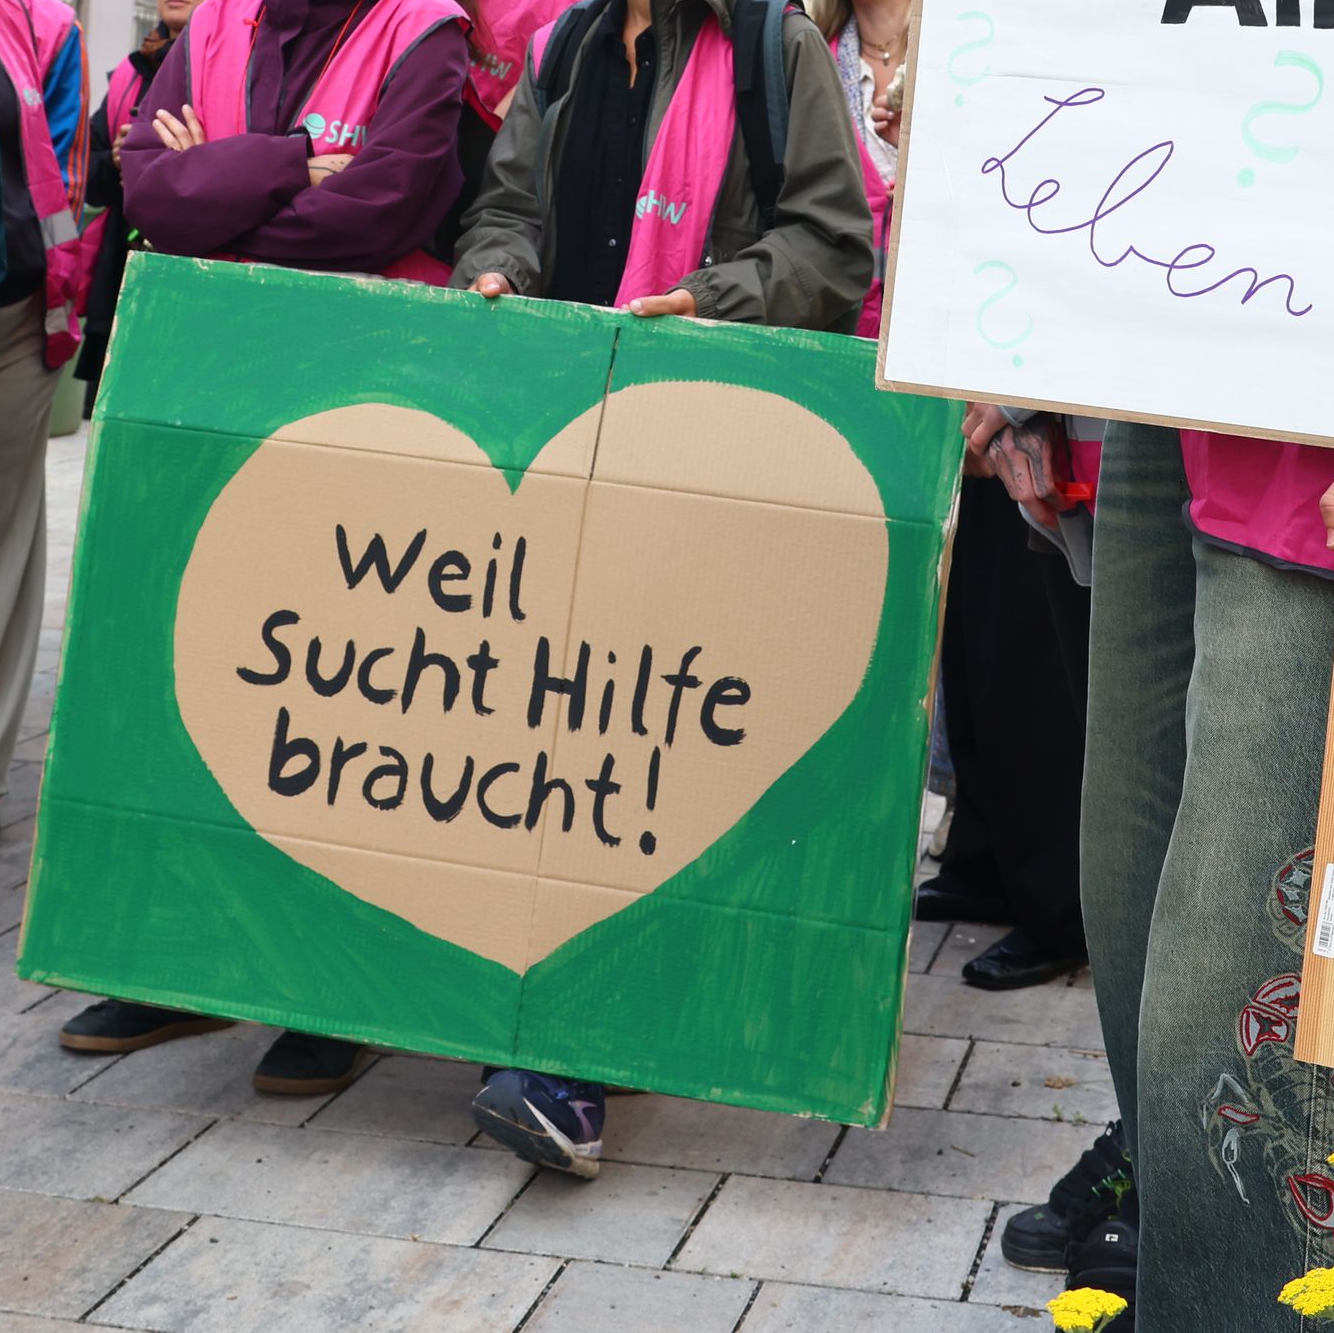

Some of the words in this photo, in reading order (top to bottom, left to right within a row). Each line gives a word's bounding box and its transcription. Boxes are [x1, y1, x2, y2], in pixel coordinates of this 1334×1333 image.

[325, 120, 368, 147] SH
[982, 88, 1313, 317] Leben
[527, 636, 752, 748] Hilfe
[268, 705, 661, 856] braucht!
